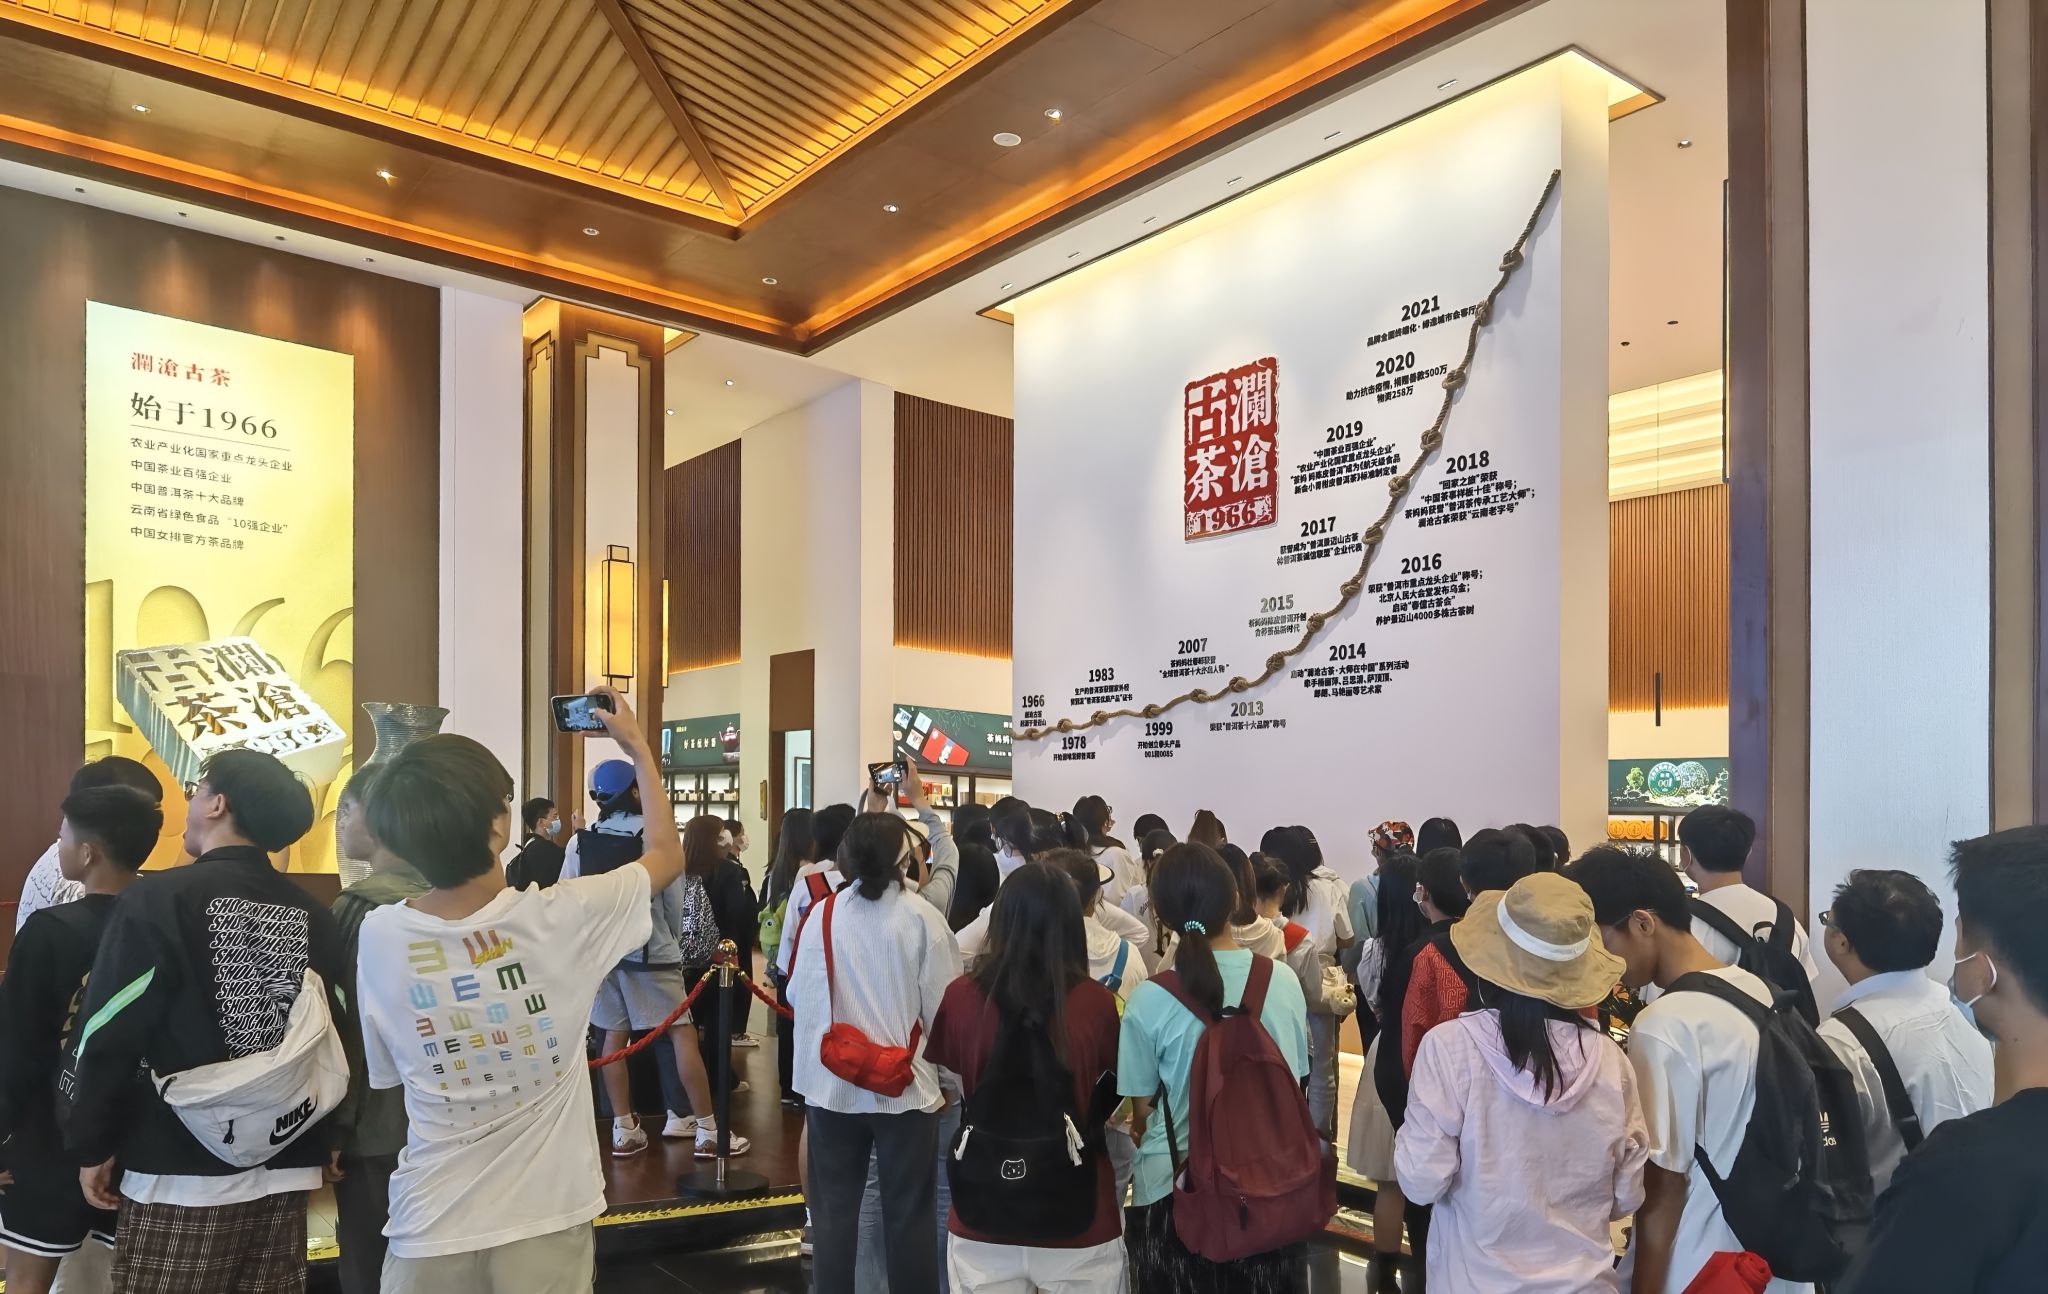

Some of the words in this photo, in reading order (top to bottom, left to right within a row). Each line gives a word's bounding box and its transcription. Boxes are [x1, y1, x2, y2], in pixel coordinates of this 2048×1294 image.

[1401, 295, 1440, 321] 2021
[1376, 351, 1415, 378] 2020
[1376, 385, 1414, 404] 物资258万
[131, 391, 277, 439] 始于1966
[1326, 420, 1363, 443] 2019
[131, 437, 293, 472] 农业产业化国家重点龙头企业
[1446, 450, 1490, 474] 2018
[131, 459, 232, 484] 中国茶业百强企业
[131, 481, 244, 507] 中国普洱茶十大品牌
[1200, 500, 1257, 534] 1966
[1301, 516, 1336, 537] 2017
[131, 526, 244, 551] 中国女排官方茶品牌
[1401, 553, 1442, 574] 2016
[1260, 594, 1294, 613] 2015
[1178, 638, 1208, 654] 2007
[1329, 643, 1366, 661] 2014
[1089, 667, 1114, 682] 1983
[1022, 695, 1045, 708] 1966
[1231, 700, 1264, 717] 2013
[1145, 721, 1173, 736] 1999
[1062, 736, 1086, 750] 1978
[276, 1096, 311, 1133] NIKE
